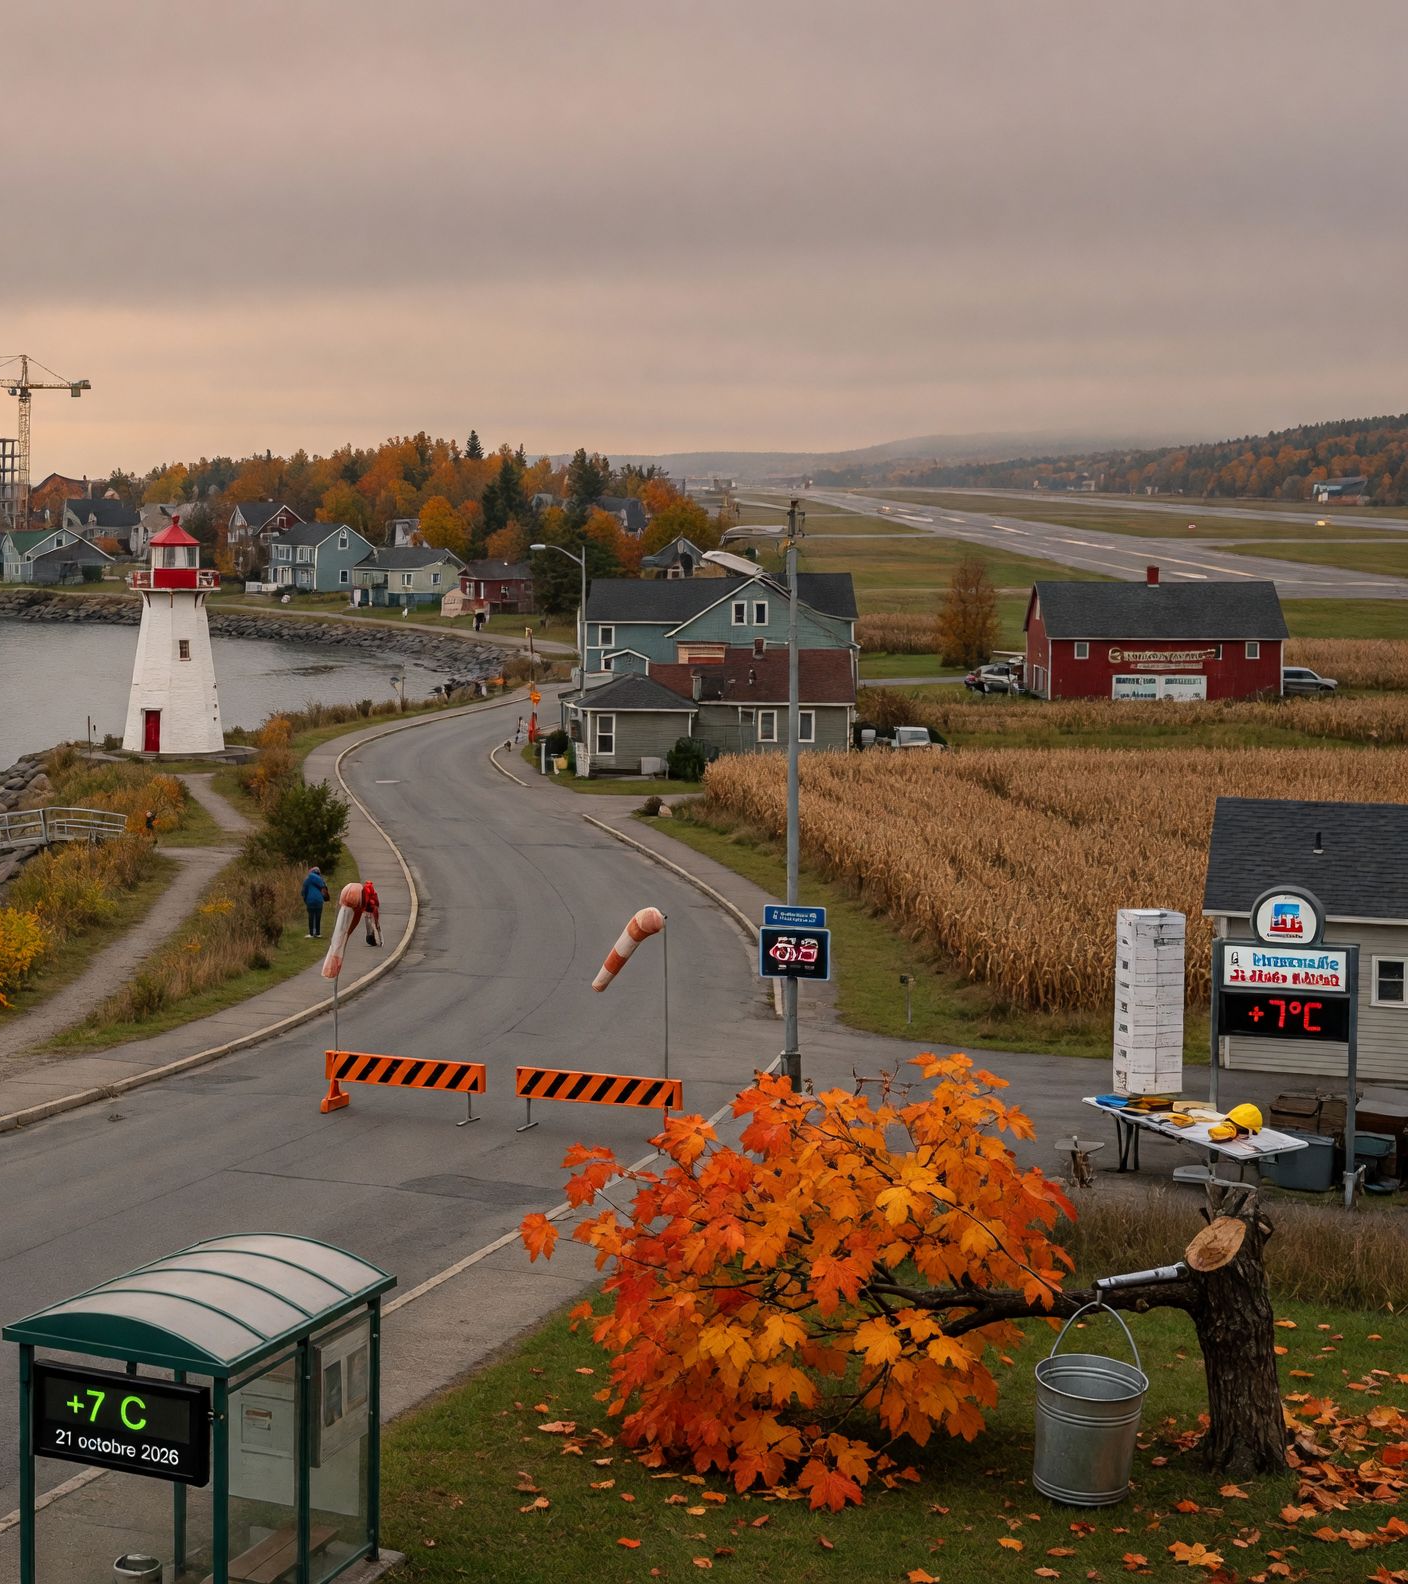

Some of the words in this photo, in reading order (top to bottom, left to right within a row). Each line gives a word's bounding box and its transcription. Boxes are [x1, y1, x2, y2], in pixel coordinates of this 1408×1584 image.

[1248, 999, 1322, 1032] +7°C
[66, 1389, 106, 1422] +7
[120, 1395, 147, 1431] C
[55, 1428, 72, 1446] 21
[78, 1436, 137, 1458] octobre
[141, 1444, 180, 1466] 2026
